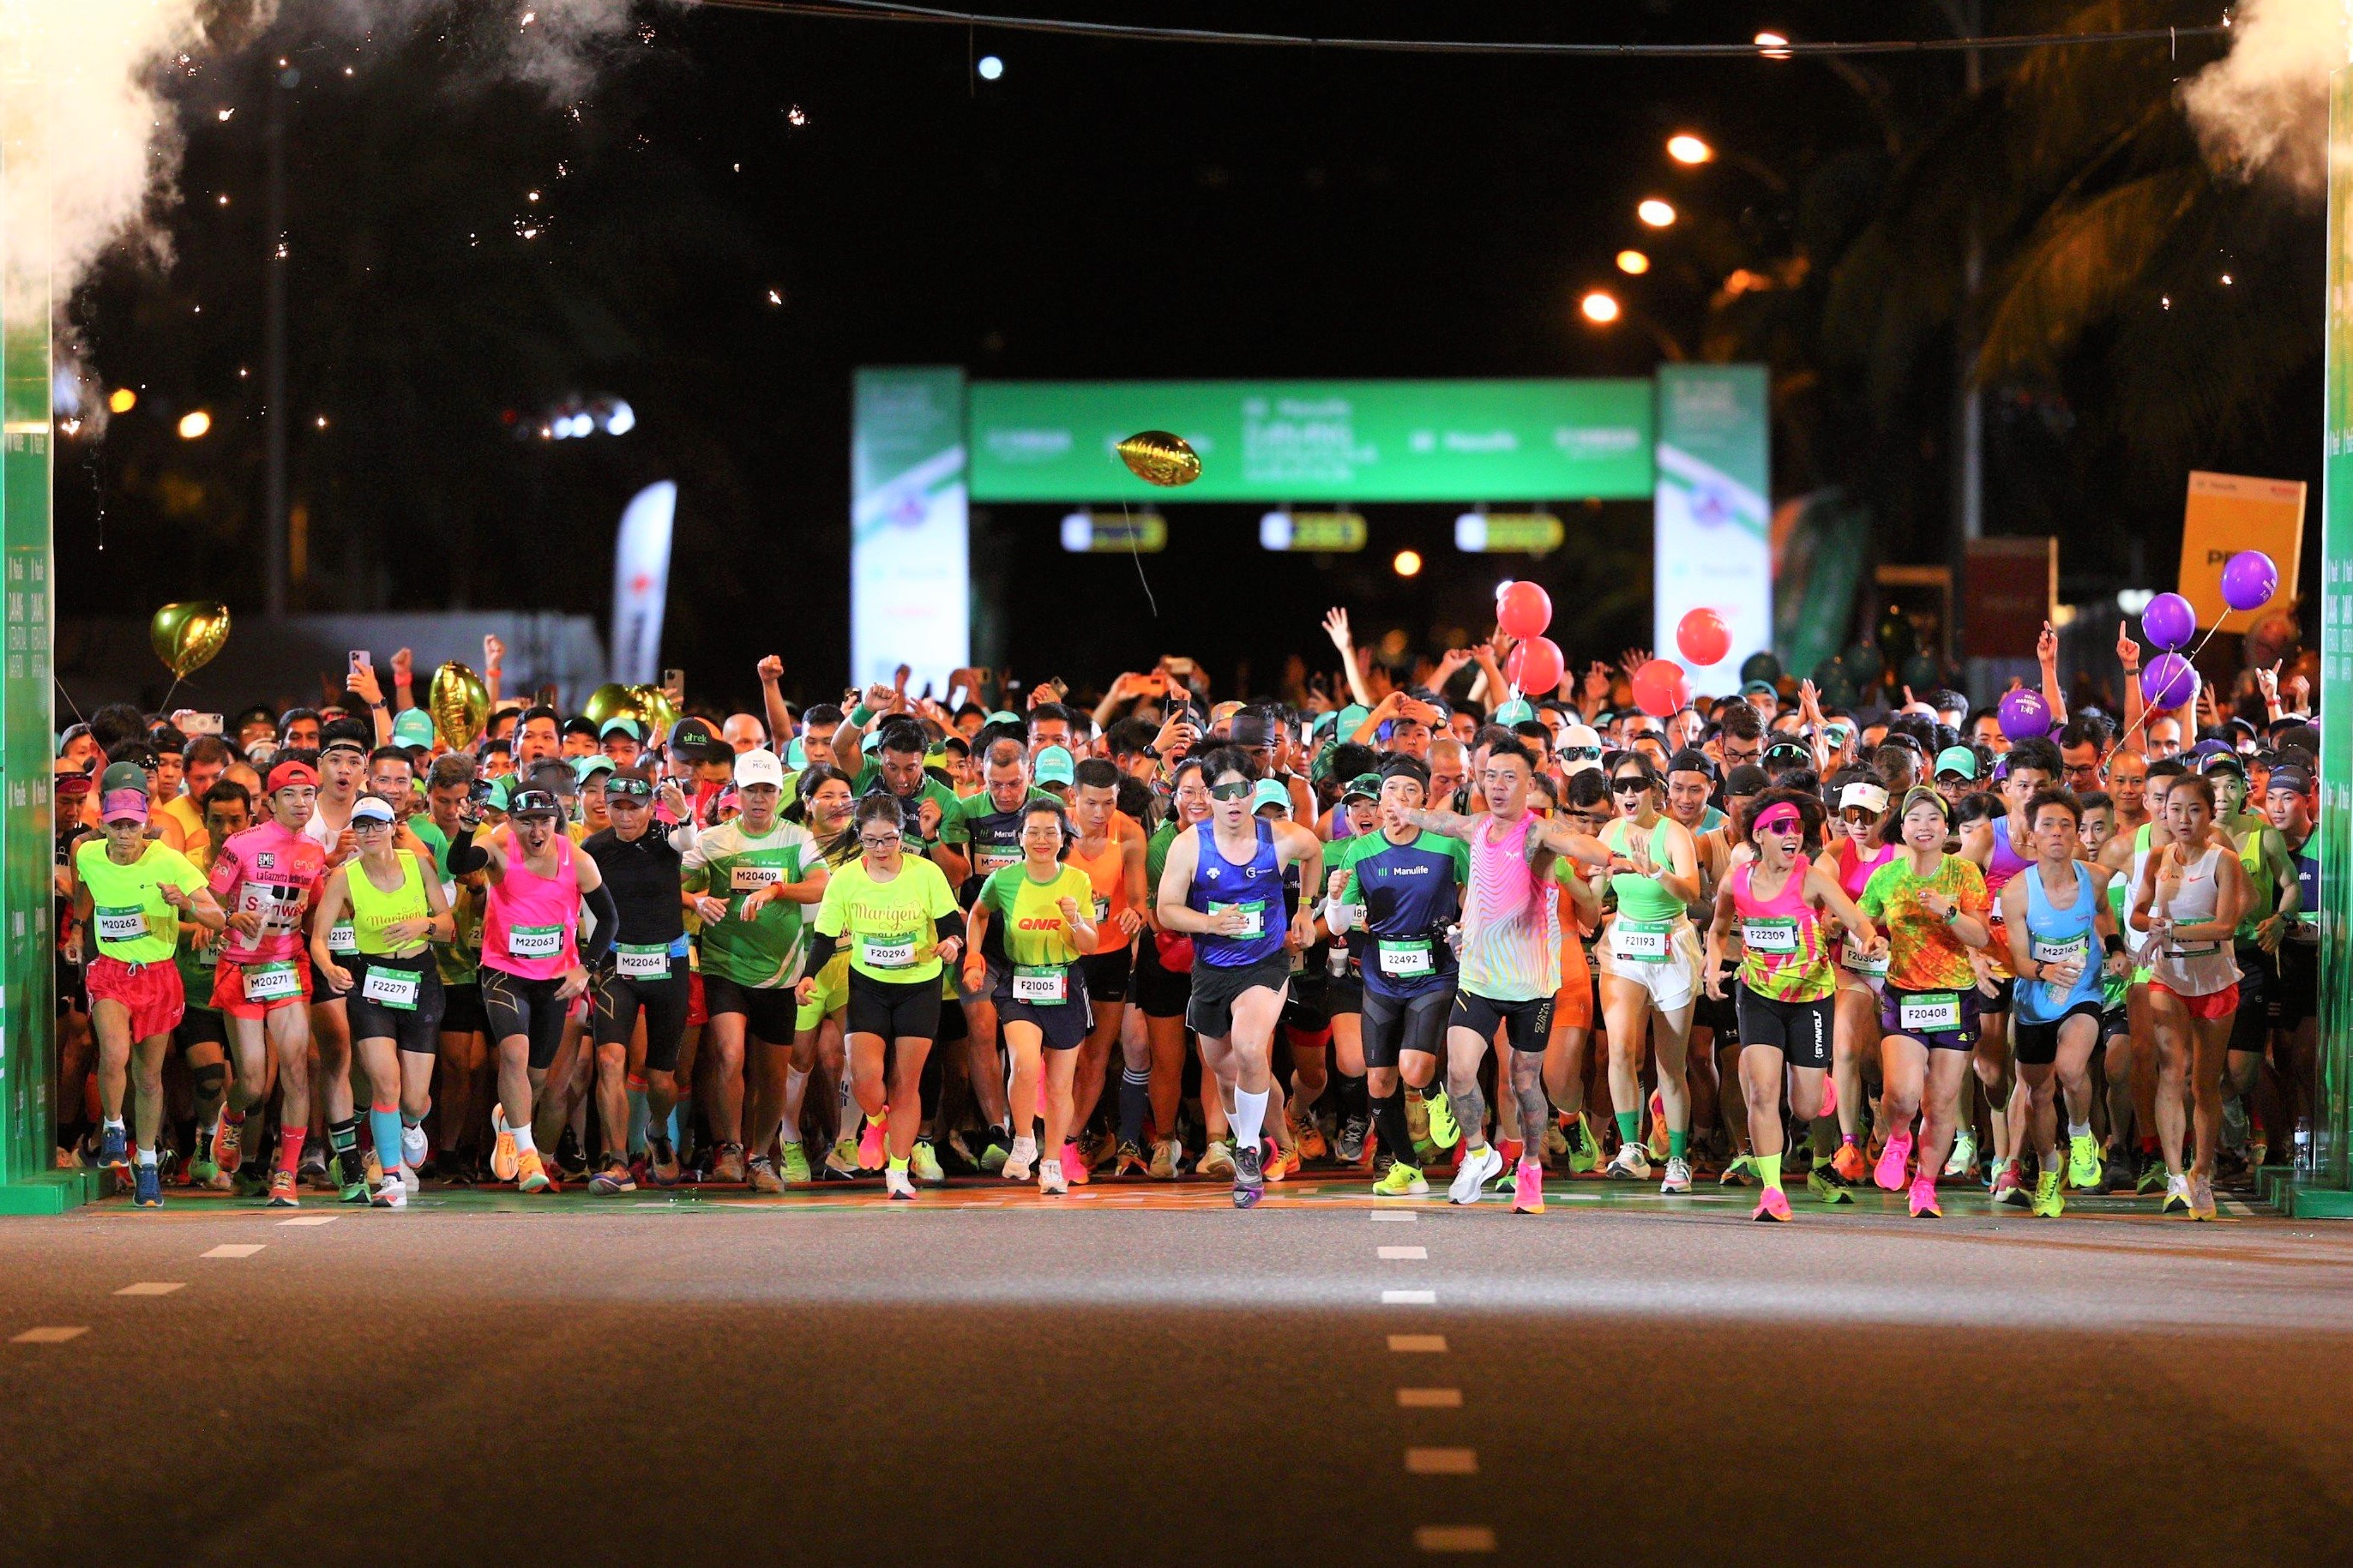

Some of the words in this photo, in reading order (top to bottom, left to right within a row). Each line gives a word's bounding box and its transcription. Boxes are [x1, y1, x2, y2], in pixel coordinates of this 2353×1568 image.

[2015, 698, 2042, 710] MARATHON
[2020, 705, 2034, 715] 1:45
[994, 829, 1016, 838] Manul
[293, 859, 315, 872] enel
[1393, 865, 1429, 876] Manulife
[256, 871, 264, 880] La
[264, 871, 288, 883] Gazzetta
[737, 871, 777, 881] M20409
[852, 898, 921, 931] Marigen
[102, 918, 138, 928] M20262
[1018, 918, 1062, 931] QNR
[328, 931, 355, 941] 2127
[1750, 930, 1785, 940] F22309
[515, 937, 555, 946] M22063
[1625, 936, 1656, 946] F21193
[870, 948, 906, 958] F20296
[2043, 944, 2079, 956] M22163
[622, 957, 660, 967] M22064
[1388, 955, 1418, 964] 22492
[250, 974, 288, 988] M20271
[1020, 980, 1055, 991] F21005
[372, 981, 407, 994] F22279
[1909, 1007, 1947, 1019] F20408
[1812, 1009, 1824, 1055] GYMWOLF
